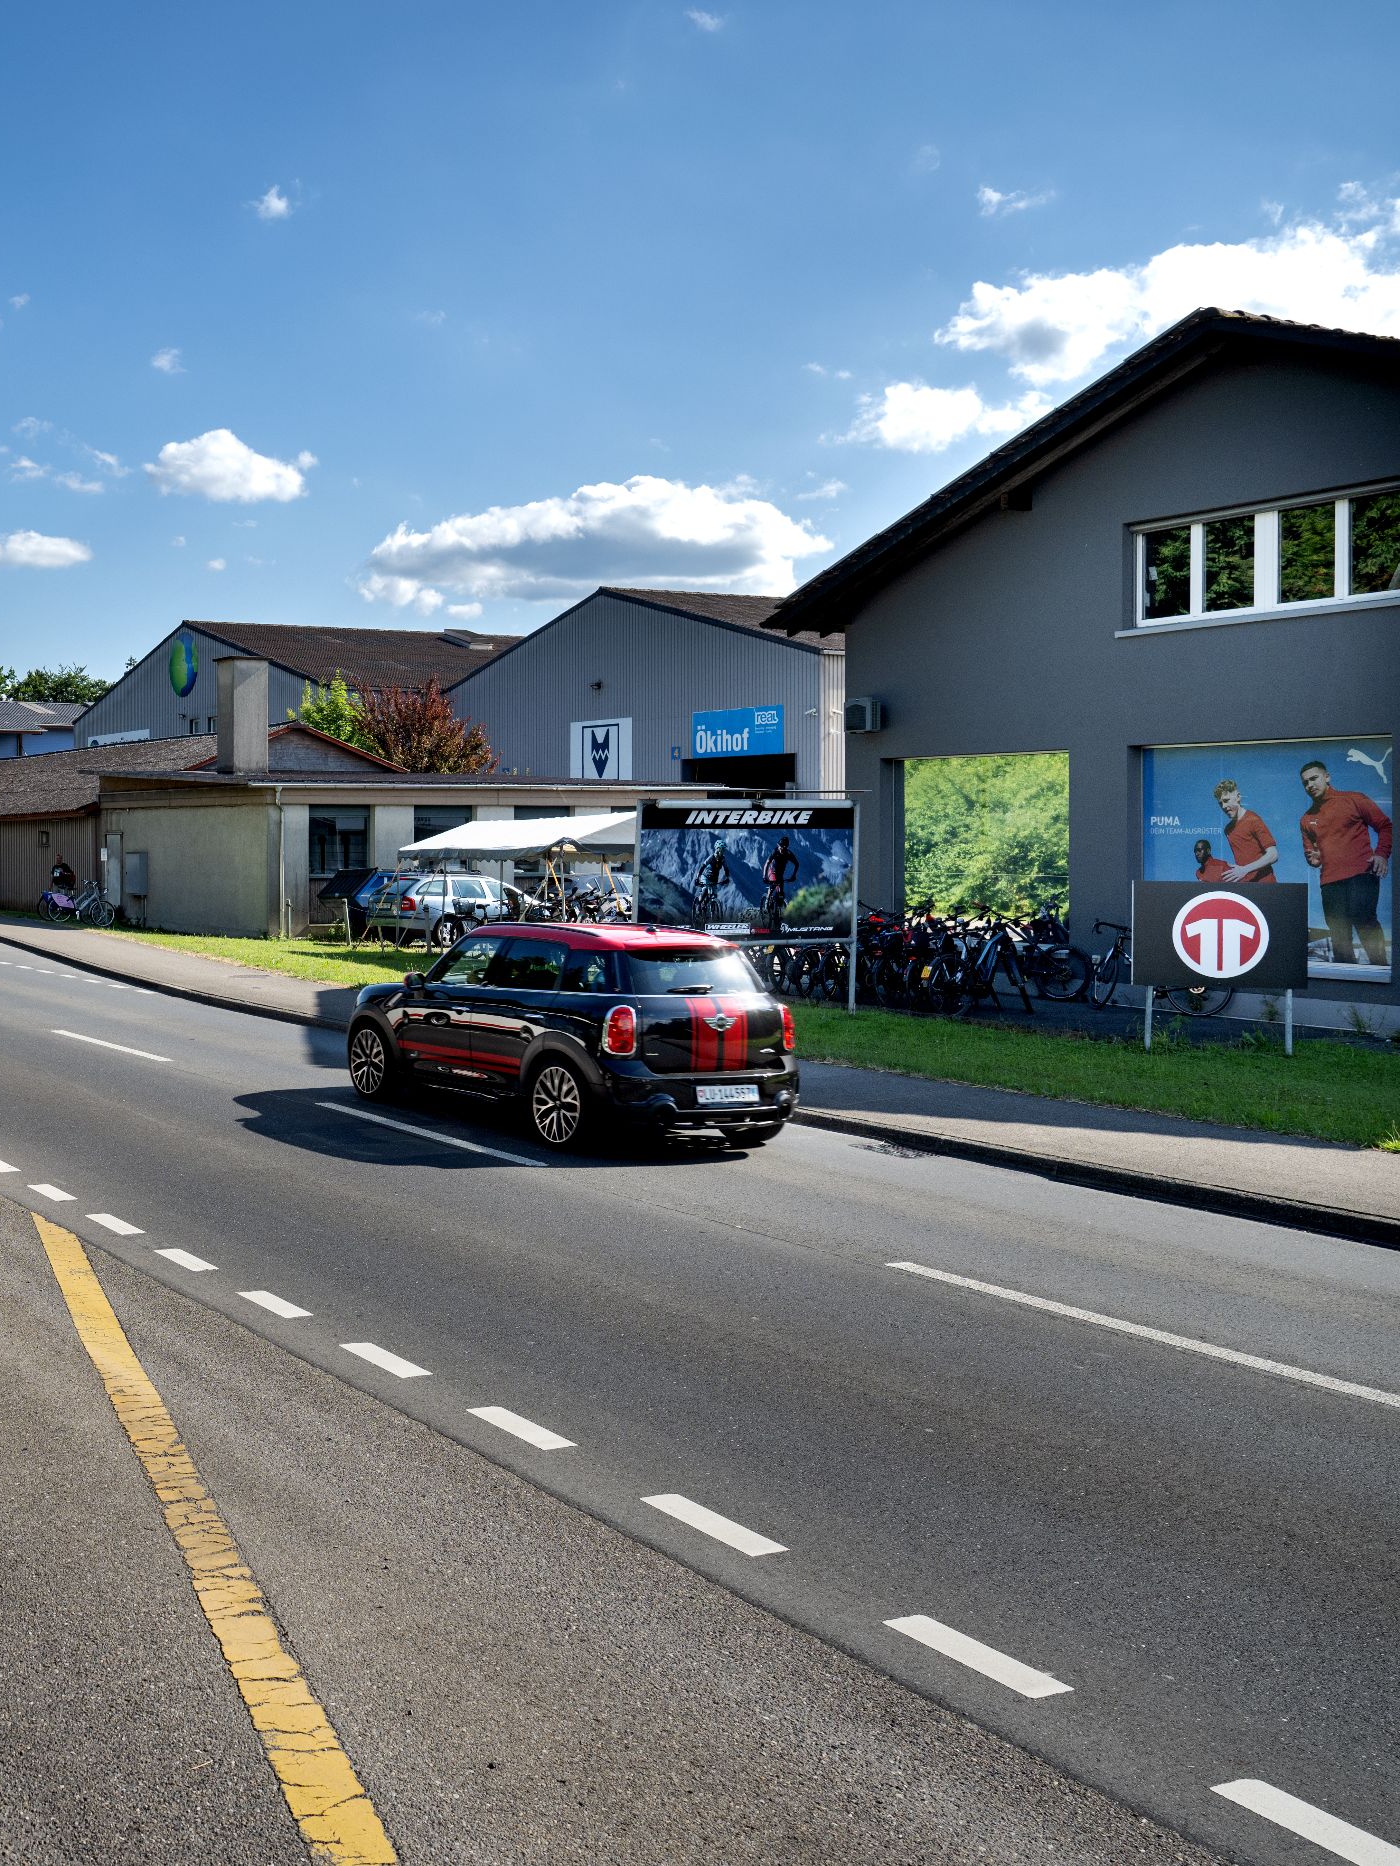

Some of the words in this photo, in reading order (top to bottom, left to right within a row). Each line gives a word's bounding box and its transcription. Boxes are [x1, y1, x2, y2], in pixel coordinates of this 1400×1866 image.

[696, 725, 749, 754] Ökihof
[685, 810, 813, 825] INTERBIKE
[1150, 816, 1181, 827] PUMA
[1166, 826, 1222, 835] TEAM-AUSRÜSTER
